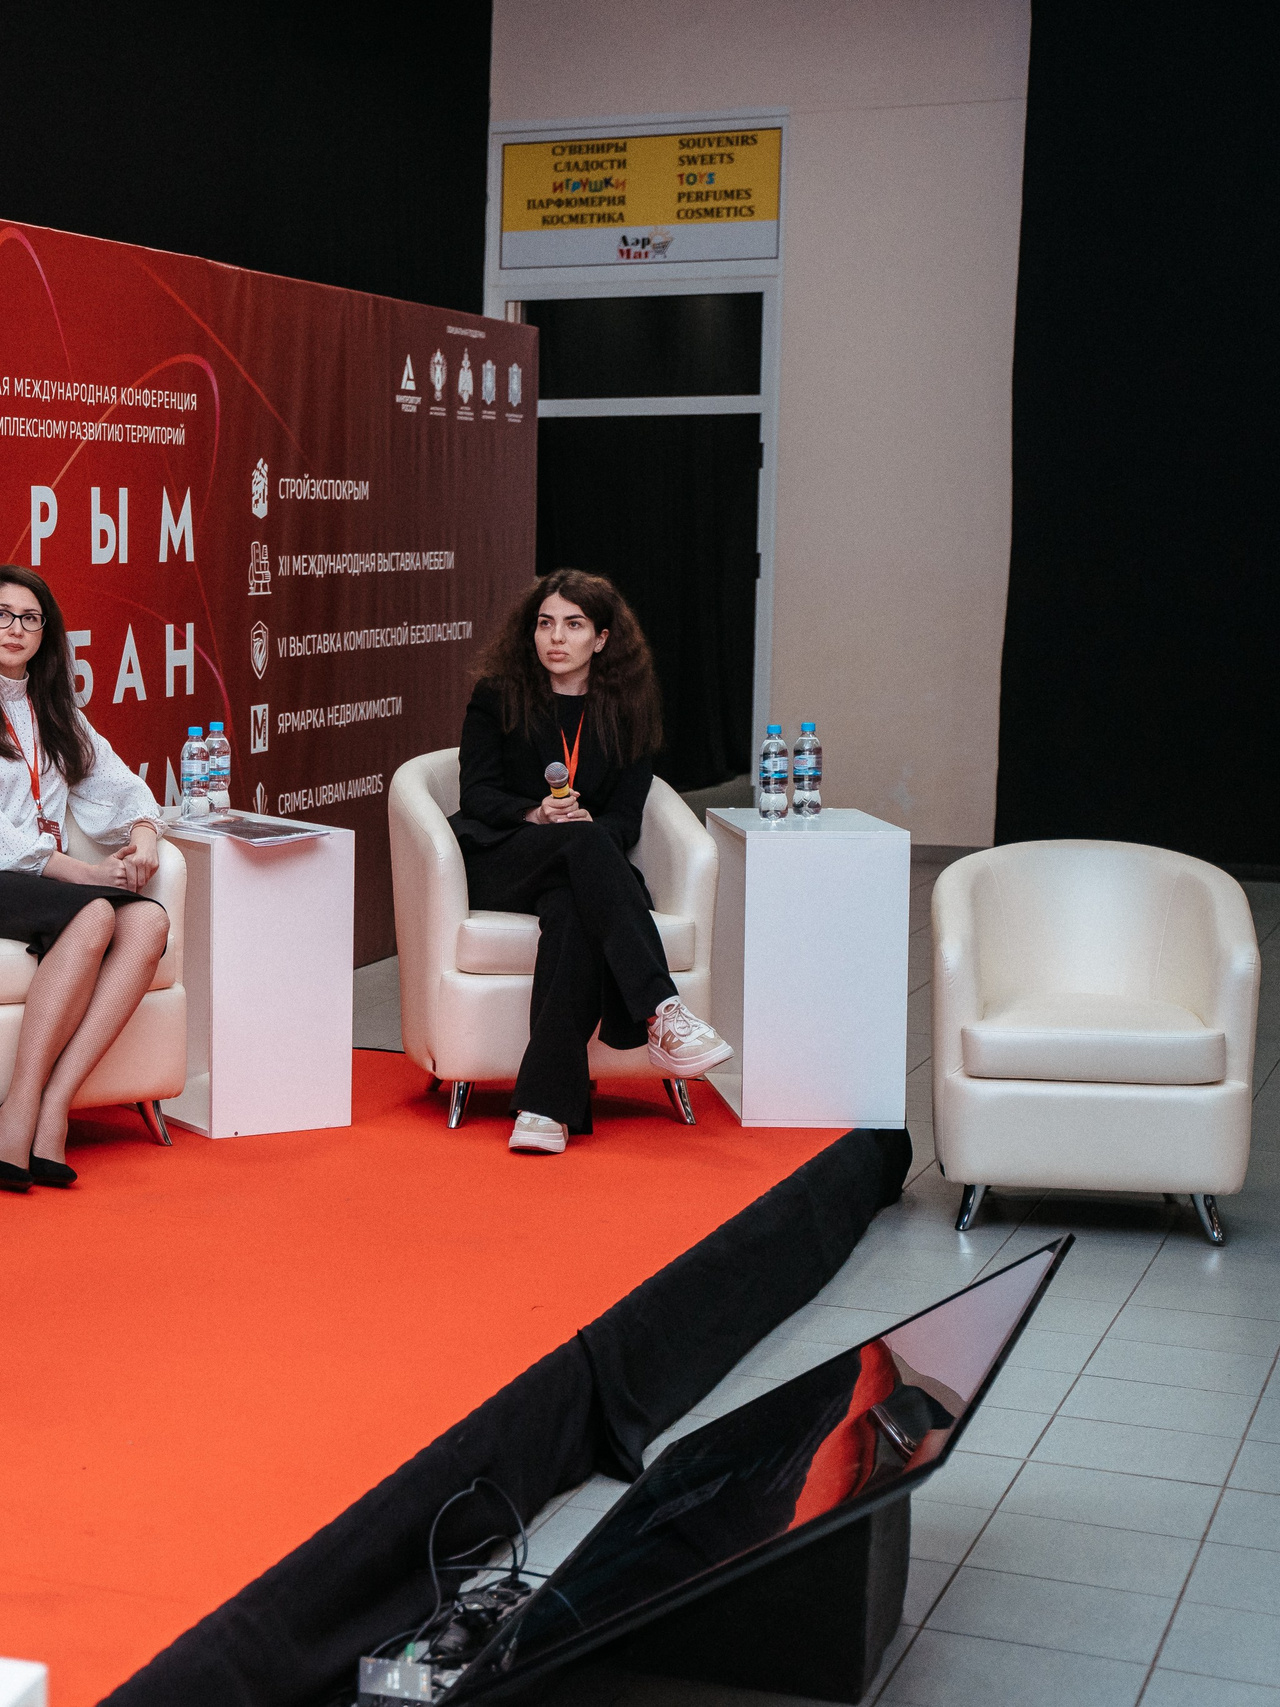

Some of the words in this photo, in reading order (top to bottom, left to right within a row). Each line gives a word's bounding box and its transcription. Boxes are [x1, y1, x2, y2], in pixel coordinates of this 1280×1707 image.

[551, 142, 627, 156] СУВЕНИРЫ
[678, 134, 758, 150] SOUVENIRS
[553, 159, 627, 173] СЛАДОСТИ
[678, 153, 735, 166] SWEETS
[677, 172, 715, 186] TOYS
[526, 195, 626, 210] ПАРФЮМЕРИЯ
[677, 188, 753, 203] PERFUMES
[541, 212, 625, 226] КОСМЕТИКА
[676, 205, 756, 220] COSMETICS
[14, 377, 118, 406] МЕЖДУНАРОДНАЯ
[121, 387, 197, 413] КОНФЕРЕНЦИЯ
[70, 421, 123, 443] РАЗВИТИЮ
[125, 423, 186, 446] ТЕРРИТОРИЙ
[278, 473, 370, 501] СТРОЙЭКСПОКРЫМ
[278, 556, 290, 576] XII
[292, 553, 376, 578] МЕЖДУНАРОДНАЯ
[377, 551, 421, 572] ВЫСТАВКА
[422, 550, 455, 570] МЕБЕЛИ
[277, 637, 288, 658] VI
[289, 630, 342, 657] ВЫСТАВКА
[343, 622, 409, 652] КОМПЛЕКСНОЙ
[410, 621, 473, 645] БЕЗОПАСНОСТИ
[277, 707, 326, 734] ЯРМАРКА
[327, 696, 403, 727] НЕДВИЖИМОСТИ
[277, 789, 315, 815] CRIMEA
[314, 777, 346, 808] URBAN
[346, 773, 384, 801] AWARDS
